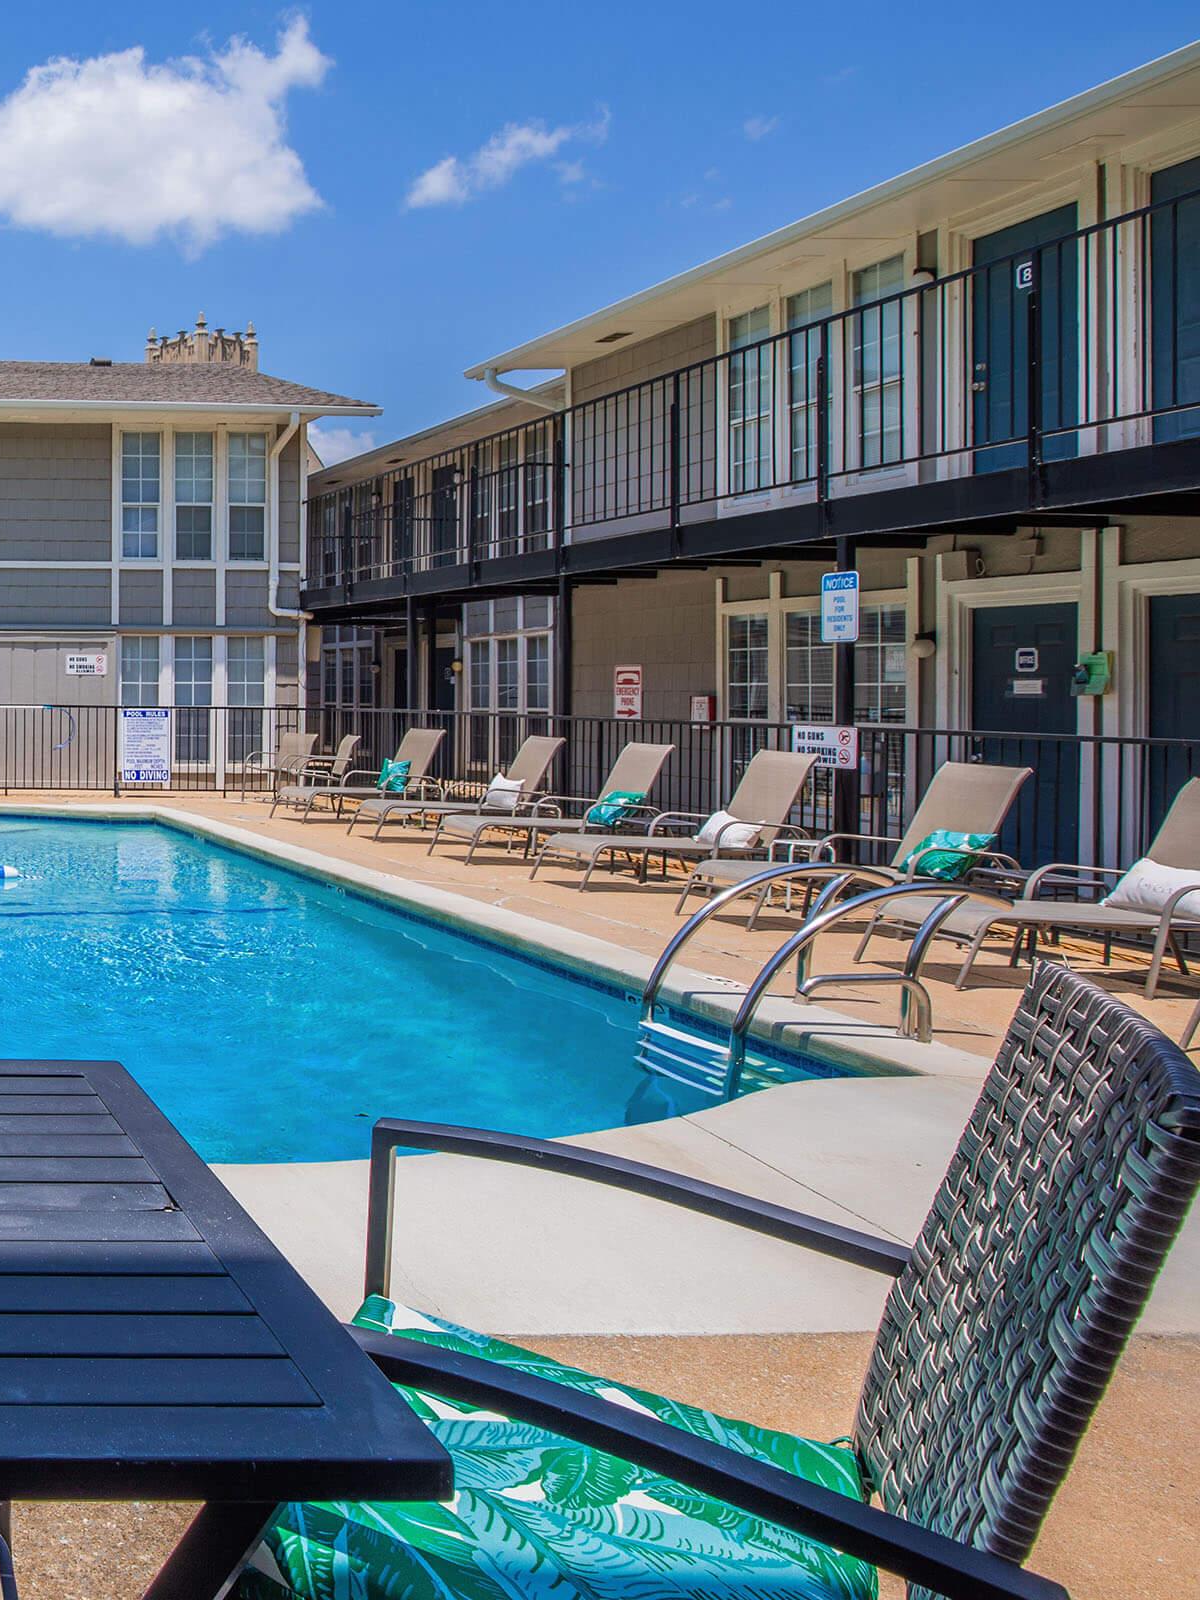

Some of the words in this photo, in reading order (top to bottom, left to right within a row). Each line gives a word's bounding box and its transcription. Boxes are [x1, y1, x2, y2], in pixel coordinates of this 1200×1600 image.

[825, 575, 854, 590] NOTICE
[616, 688, 640, 696] EMERGENCY
[620, 697, 635, 706] PHONE
[798, 731, 805, 740] NO
[807, 732, 825, 741] GUNS
[797, 745, 805, 753] NO
[807, 746, 837, 757] SMOKING
[125, 770, 137, 780] NO
[140, 770, 168, 780] DIVING
